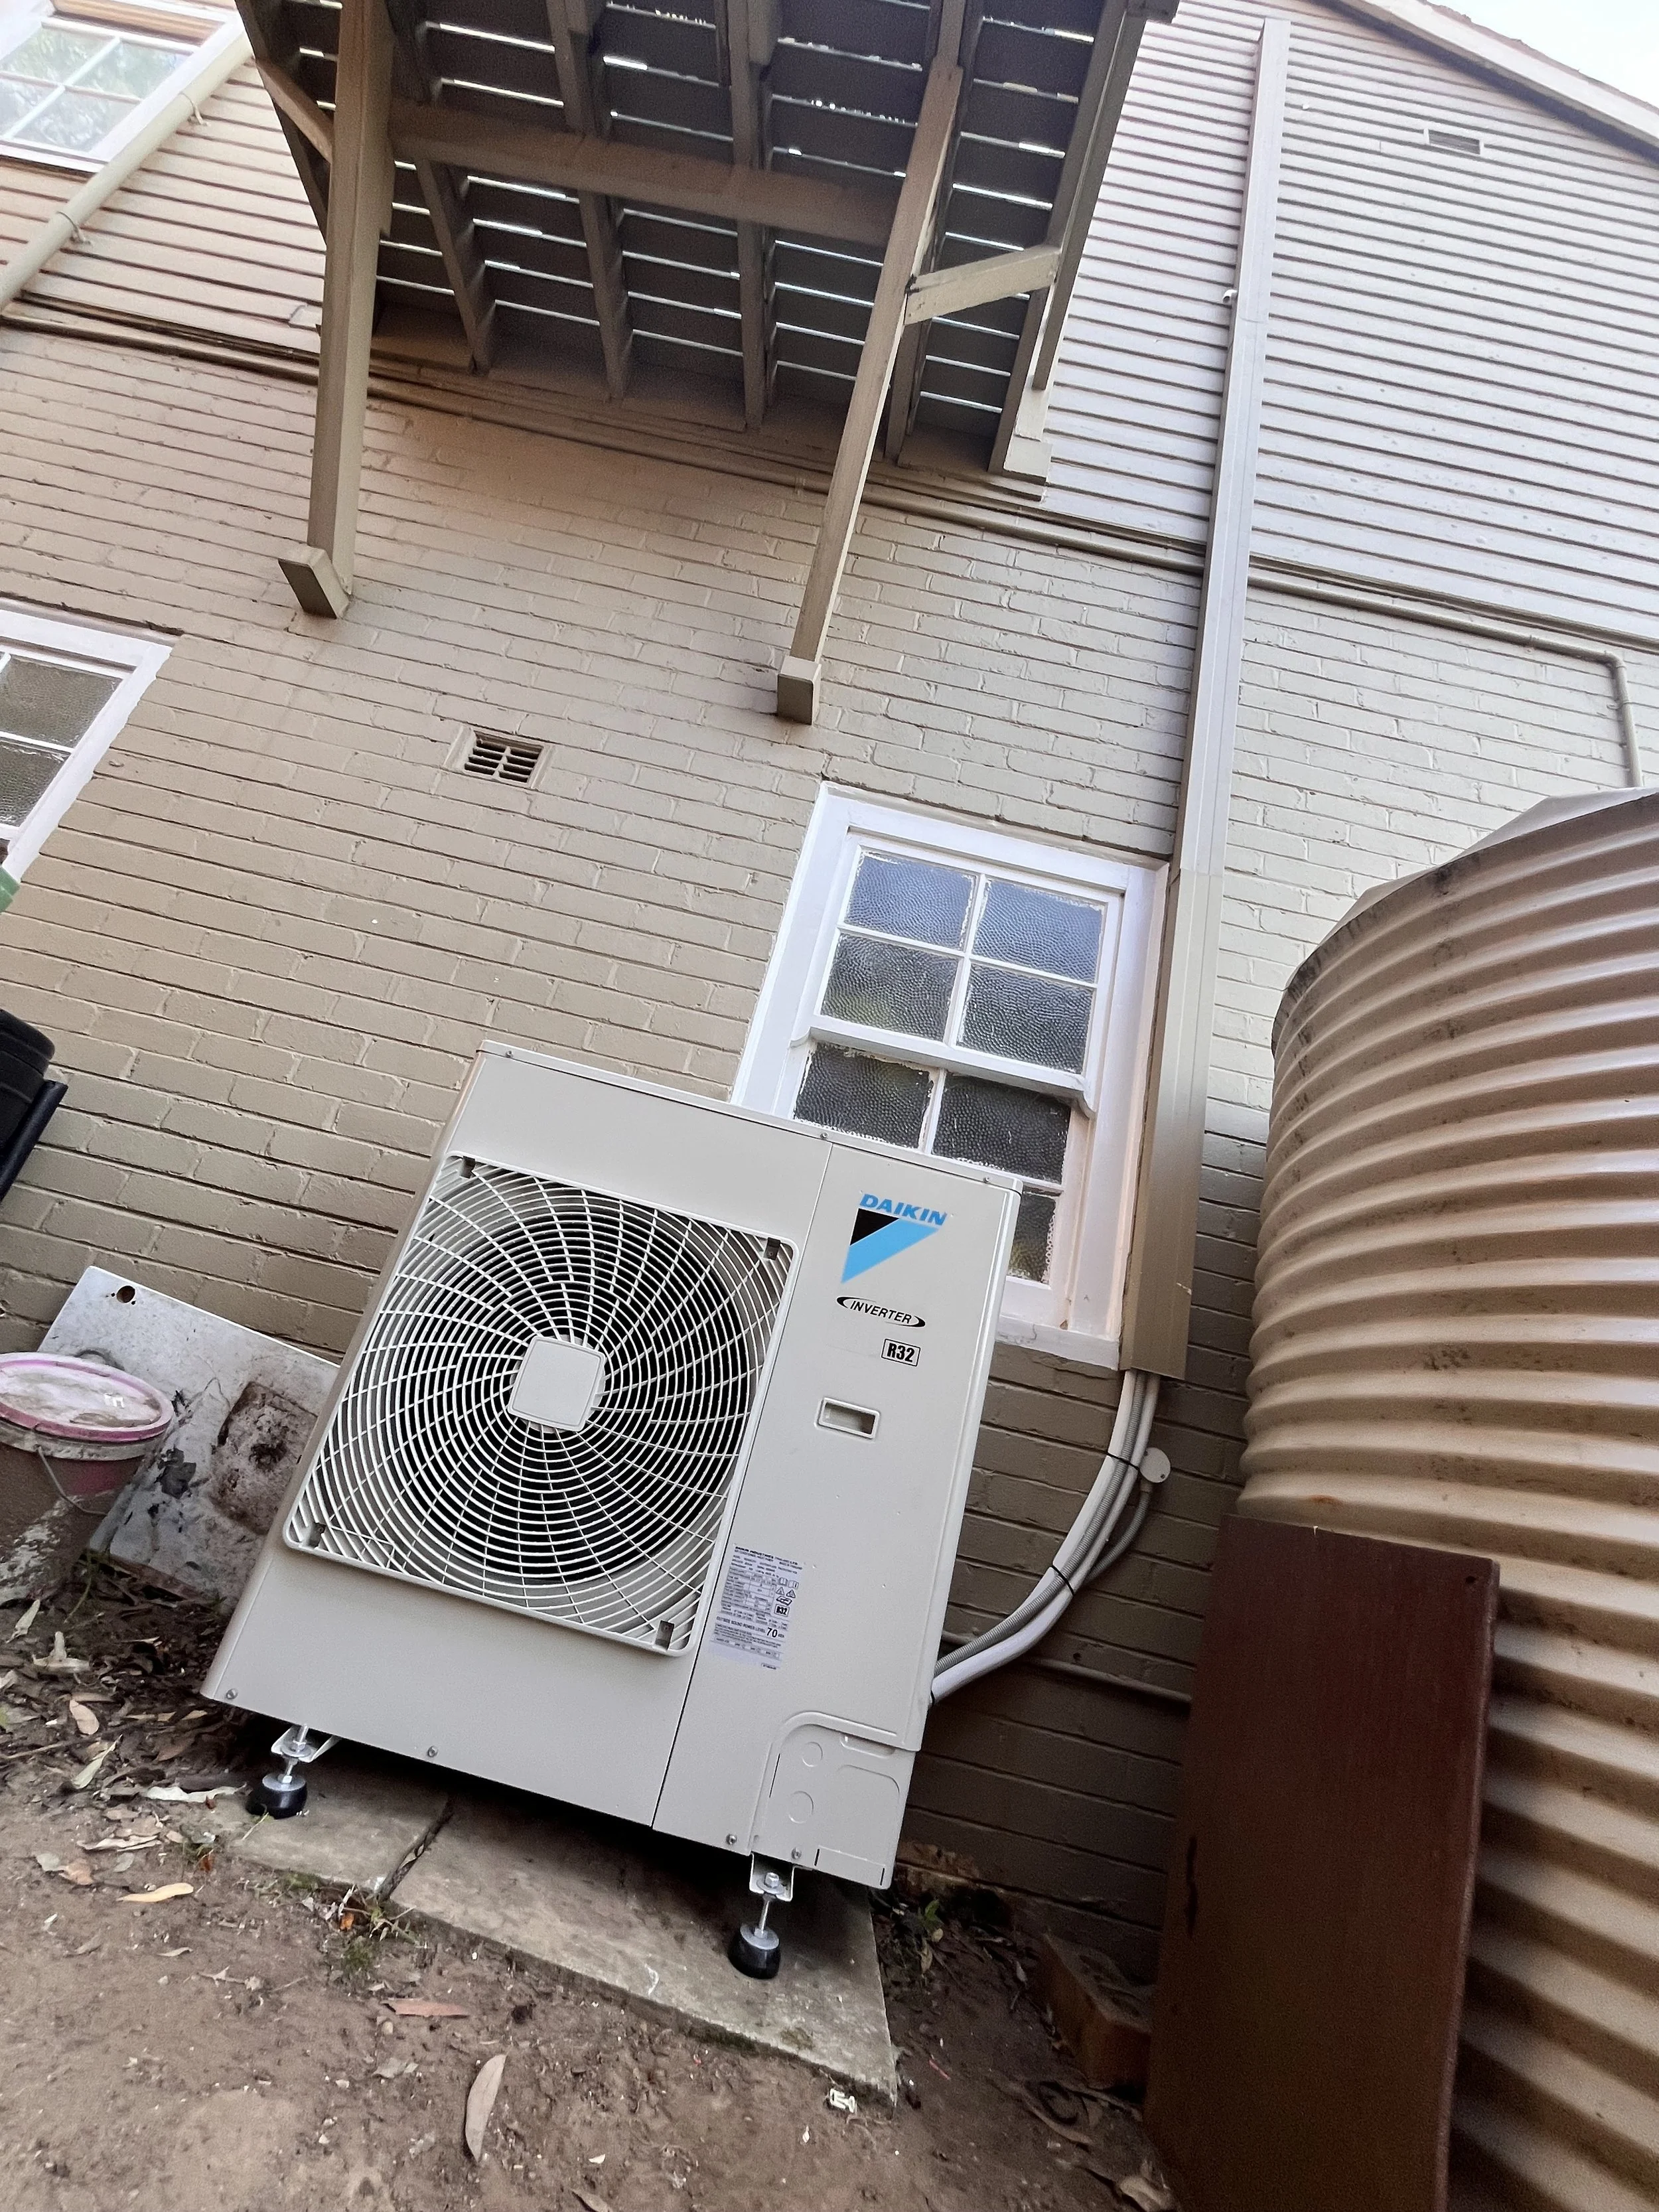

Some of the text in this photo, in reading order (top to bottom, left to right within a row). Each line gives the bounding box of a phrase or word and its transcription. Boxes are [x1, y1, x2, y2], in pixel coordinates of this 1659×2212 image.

[859, 1193, 948, 1226] DAIKIN
[850, 1300, 912, 1325] INVERTER
[887, 1342, 916, 1363] R32
[776, 1605, 788, 1615] R32
[766, 1627, 778, 1638] 70
